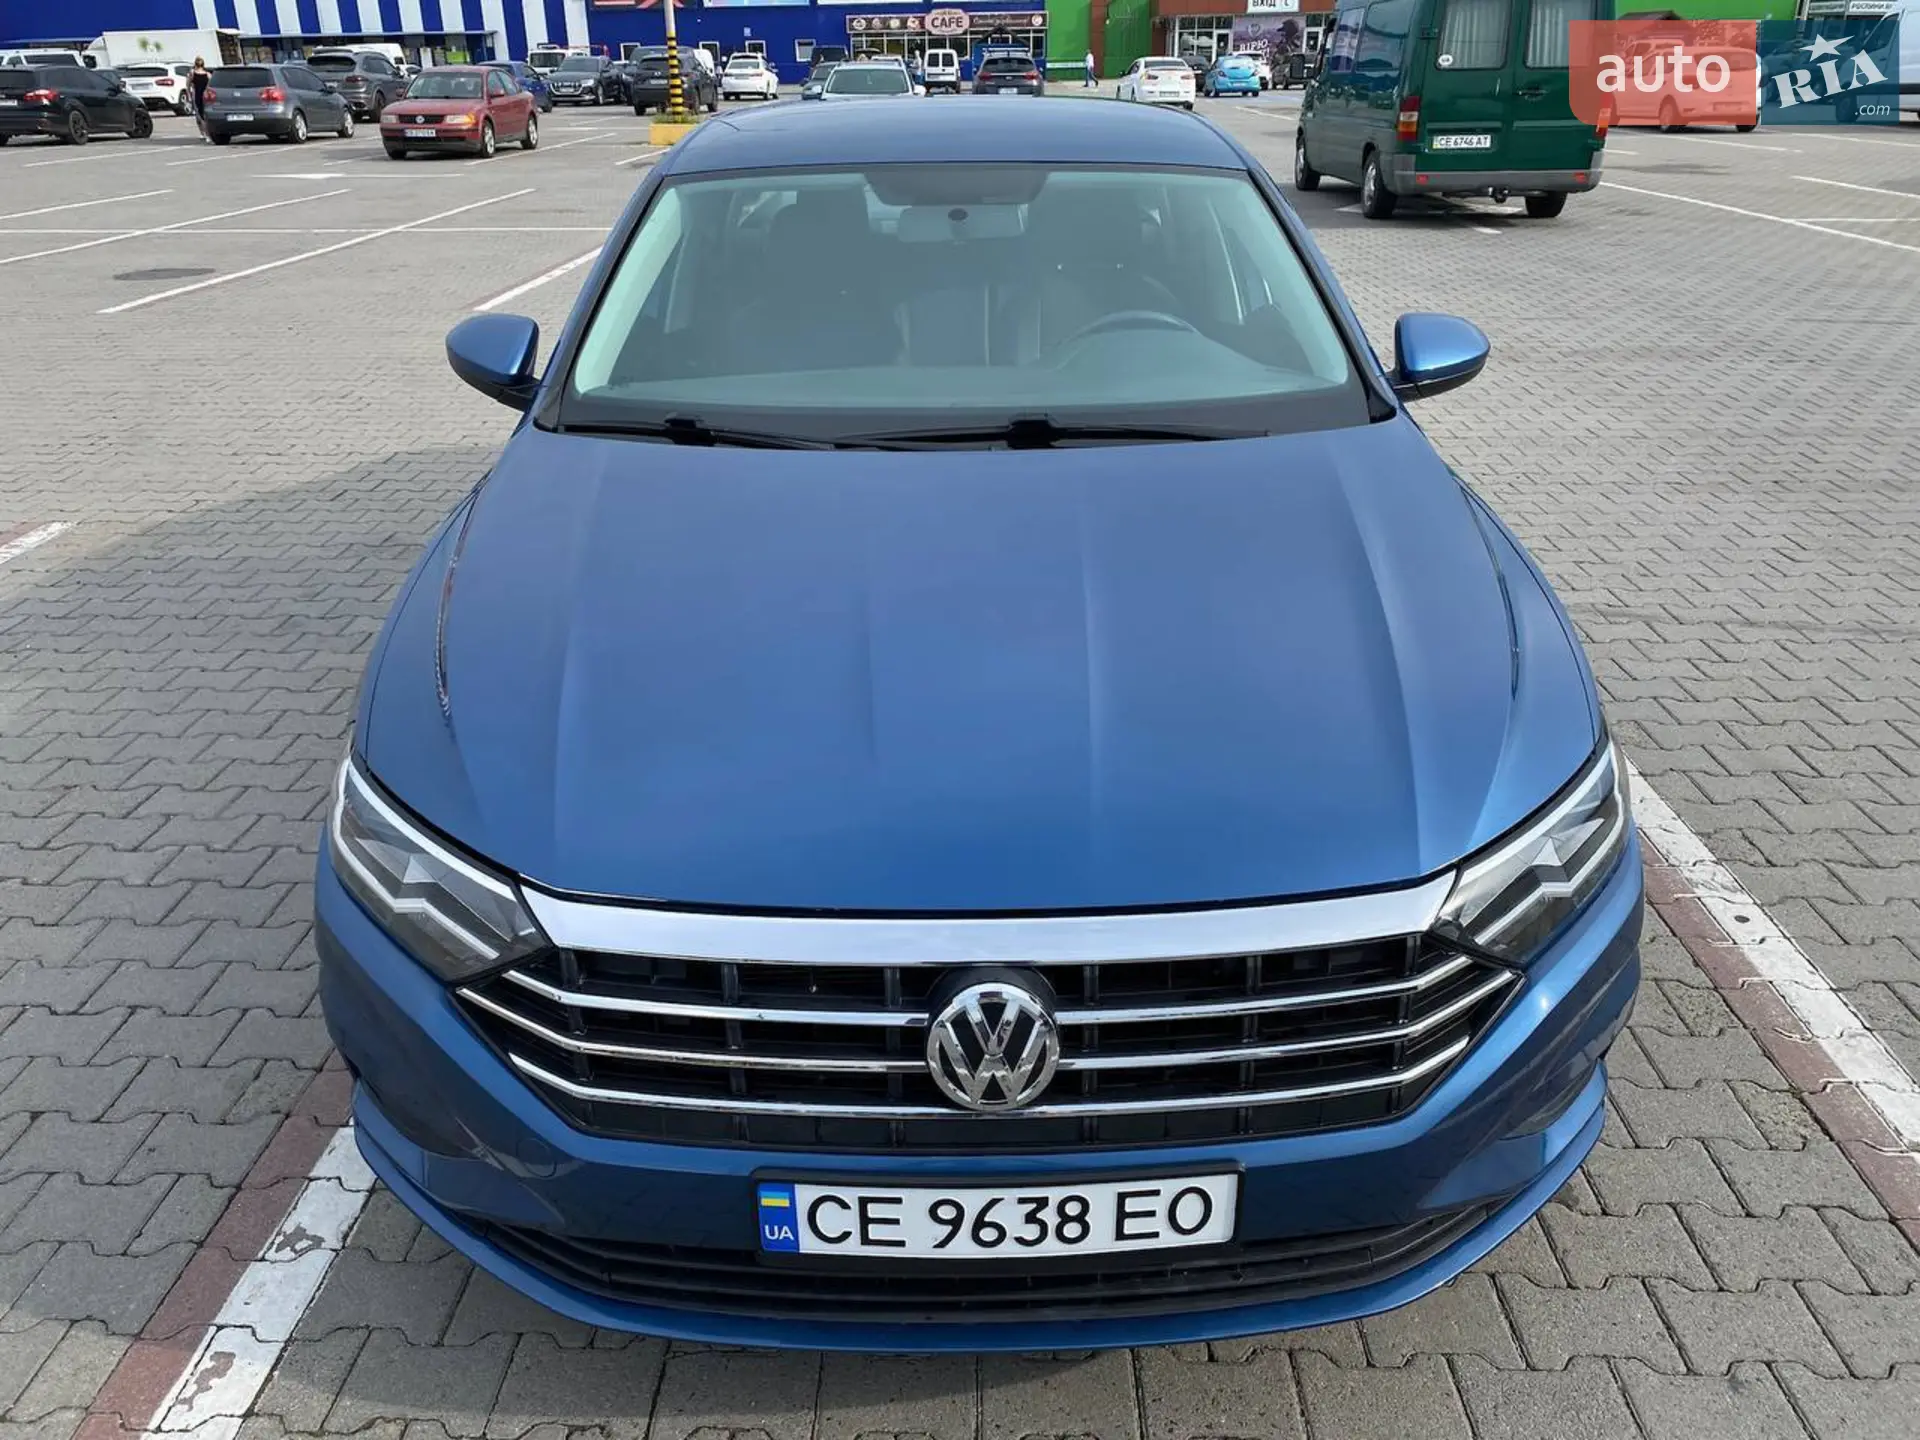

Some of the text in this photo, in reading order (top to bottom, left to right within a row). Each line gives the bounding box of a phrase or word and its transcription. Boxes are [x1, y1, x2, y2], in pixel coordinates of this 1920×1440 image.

[931, 16, 963, 28] CAFE
[1439, 137, 1452, 146] CE
[1475, 136, 1488, 145] AT
[806, 1186, 1213, 1249] CE 9638 EO
[765, 1224, 794, 1241] UA
